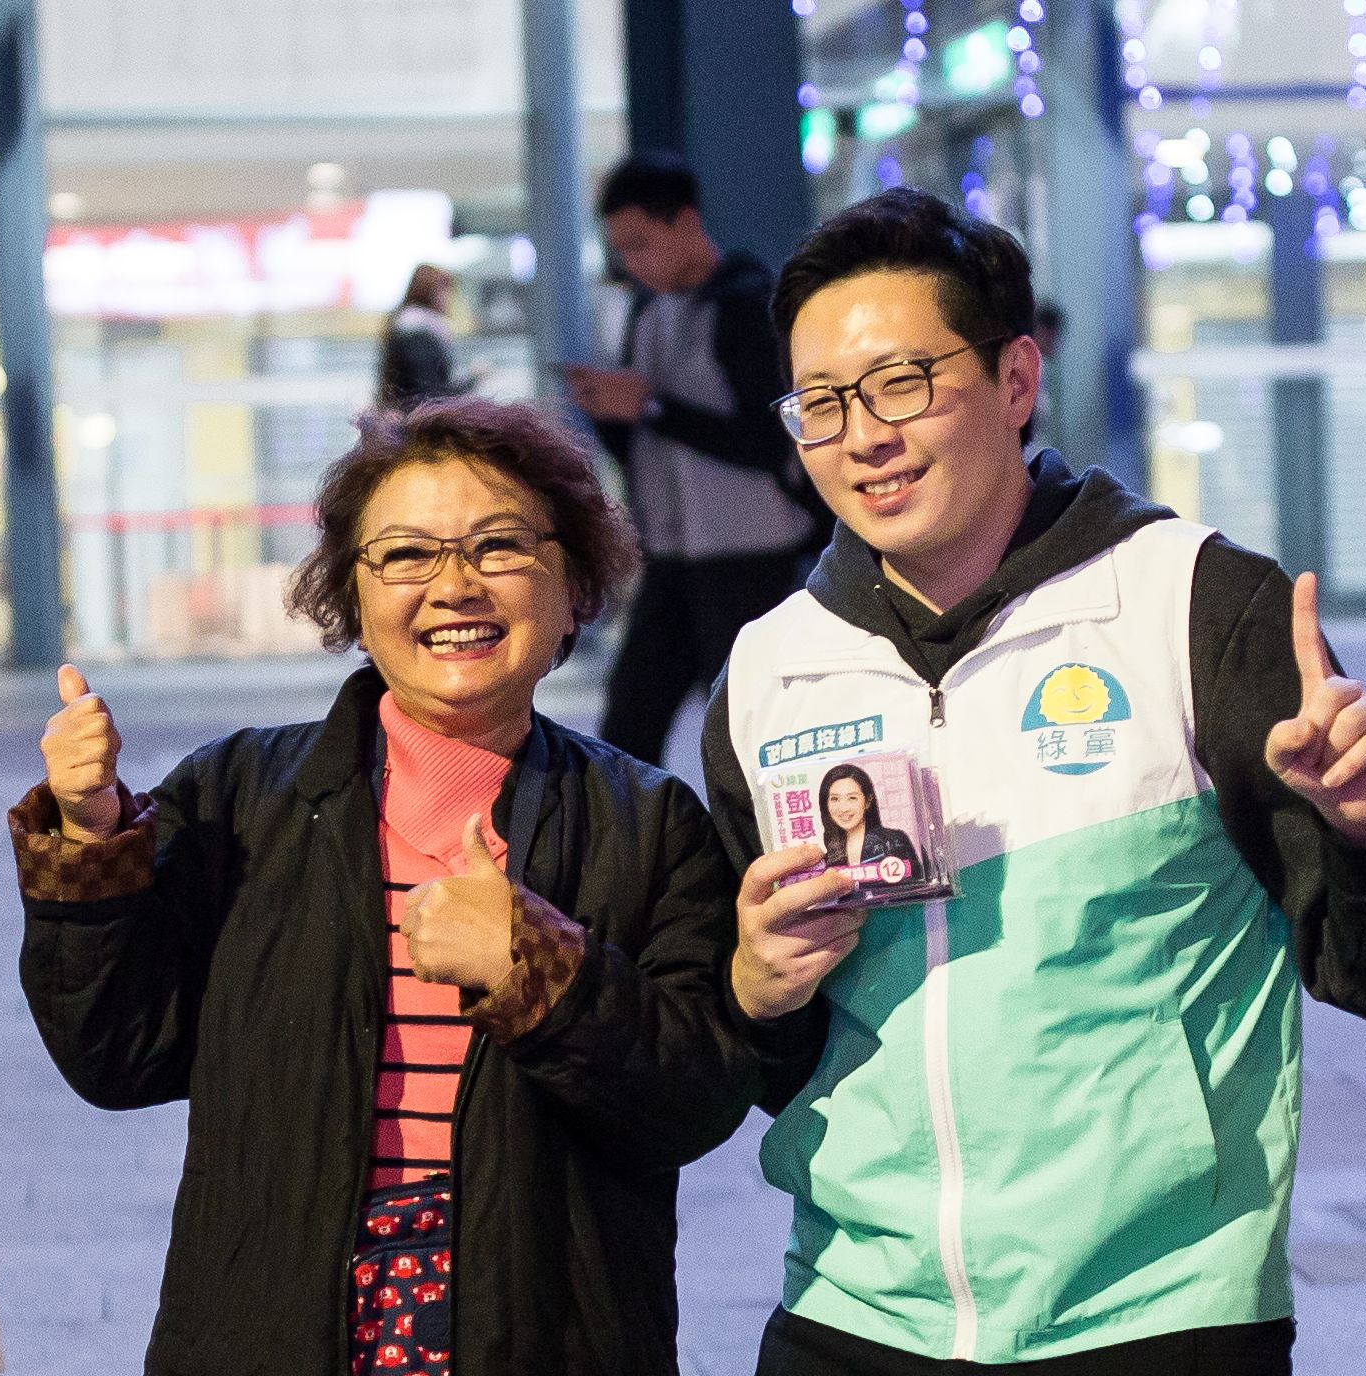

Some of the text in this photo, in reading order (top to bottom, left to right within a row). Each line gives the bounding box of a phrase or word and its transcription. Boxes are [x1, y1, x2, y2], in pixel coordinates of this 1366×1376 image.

[1037, 727, 1115, 762] 綠黨
[786, 789, 816, 845] 鄧惠
[883, 862, 901, 877] 12
